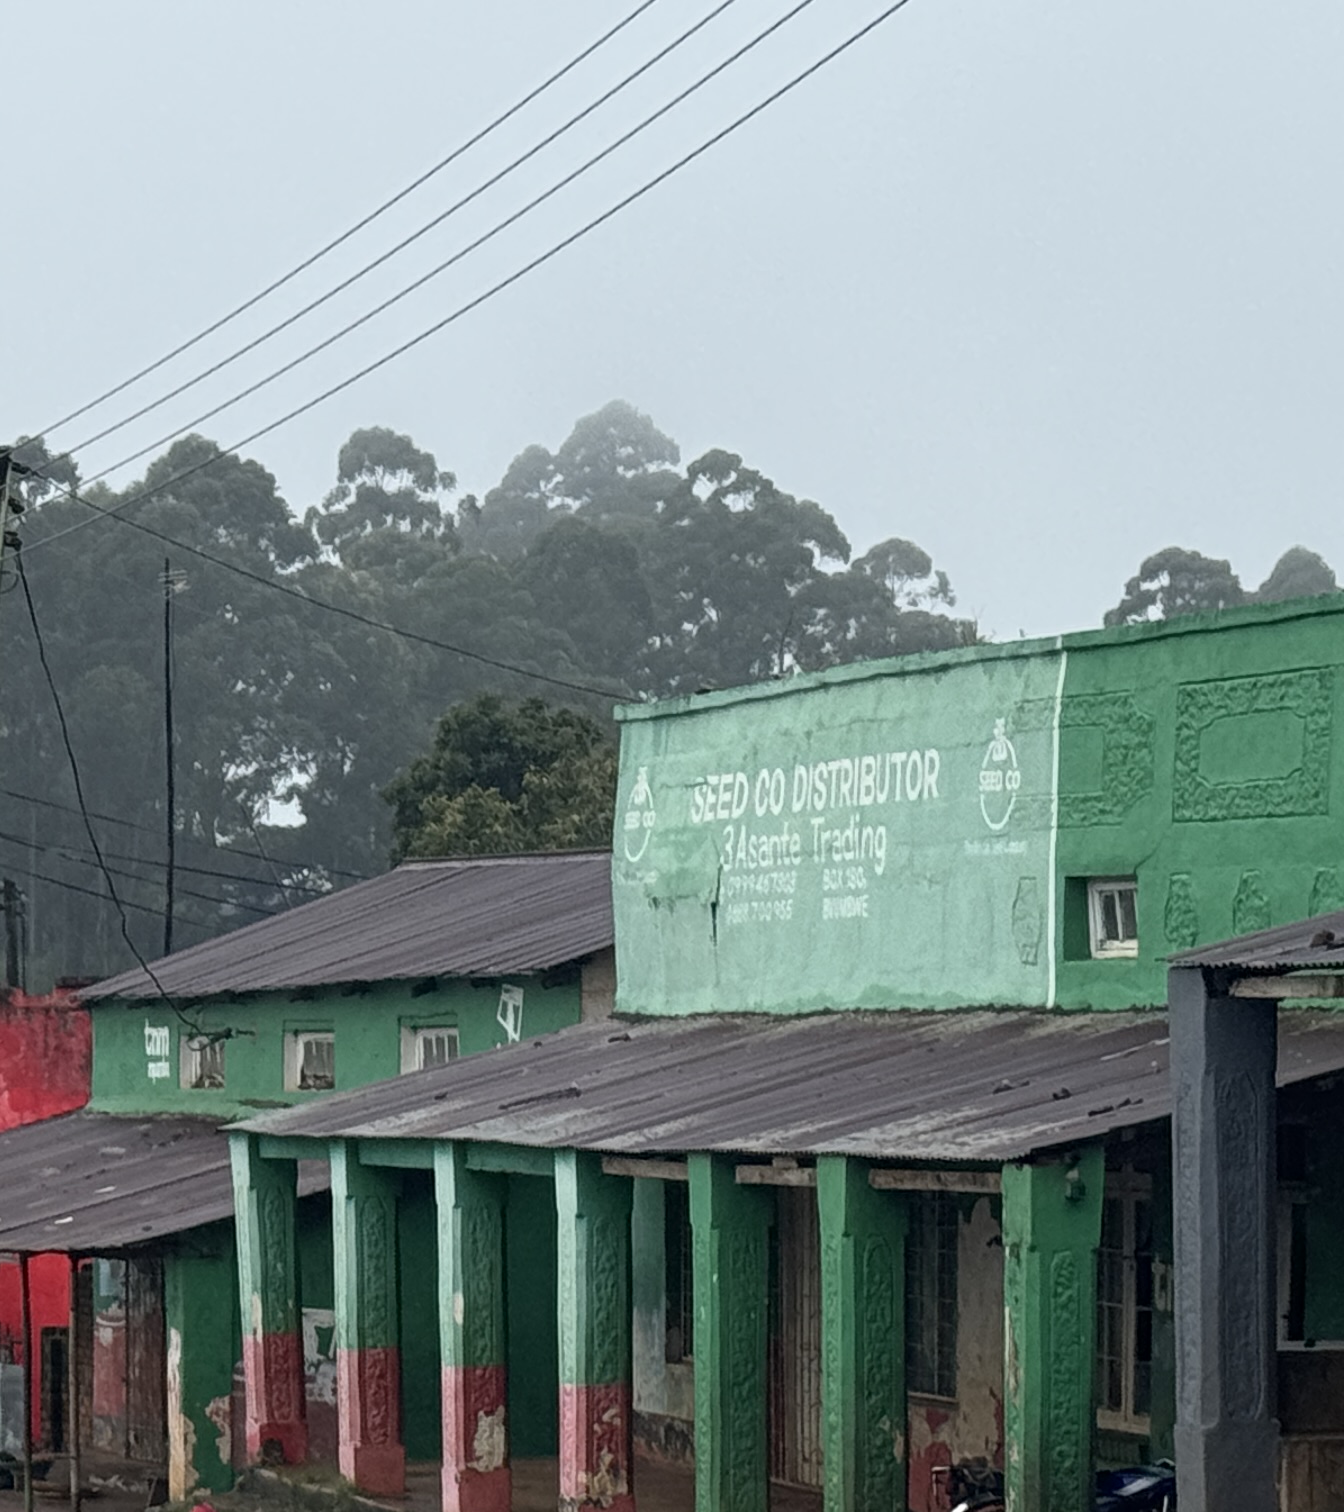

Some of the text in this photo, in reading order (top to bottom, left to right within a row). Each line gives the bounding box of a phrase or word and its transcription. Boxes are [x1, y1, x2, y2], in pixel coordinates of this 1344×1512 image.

[690, 748, 940, 824] SEED CO DISTRIBUTOR
[979, 770, 1021, 791] SEED CO
[642, 810, 656, 828] CO
[810, 812, 887, 876] Trading
